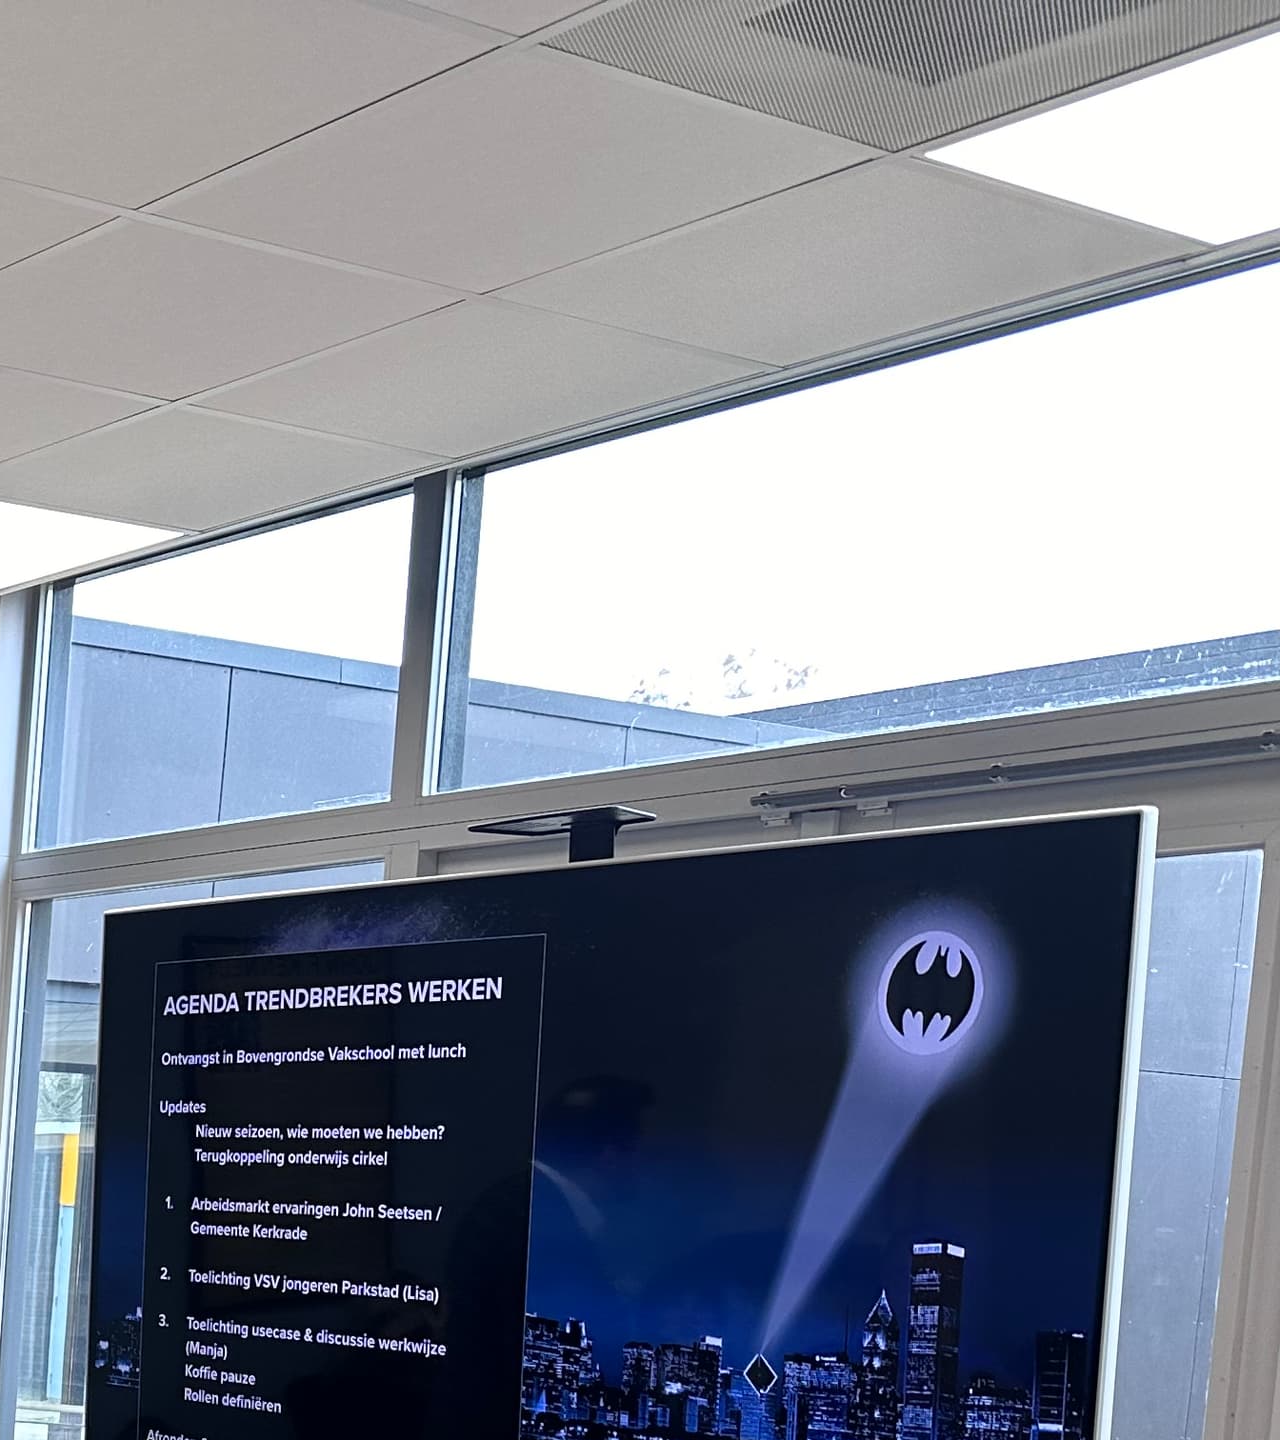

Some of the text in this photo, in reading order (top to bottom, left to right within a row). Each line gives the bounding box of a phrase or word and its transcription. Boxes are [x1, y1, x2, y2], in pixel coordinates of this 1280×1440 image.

[162, 976, 503, 1016] AGENDA TRENDBREKERS WERKEN
[161, 1042, 467, 1068] Ontvangst in Bovengrondse Vakschool met lunch
[159, 1099, 207, 1117] Updates
[195, 1123, 446, 1141] Nieuw seizoen, wie moeten we hebben?
[193, 1148, 388, 1169] Terugkoppeling onderwijs cirkel
[165, 1195, 443, 1222] 1. Arbeidsmarkt ervaringen John Seetsen /
[190, 1220, 309, 1241] Gemeente Kerkrade
[159, 1266, 440, 1306] 2. Toelichting VSV jongeren Parkstad (Lisa)
[158, 1313, 447, 1358] 3. Toelichting usecase & discussie werkwijze
[185, 1340, 228, 1361] (Manja)
[184, 1363, 256, 1386] Koffie pauze
[183, 1387, 282, 1414] Rollen definiëren
